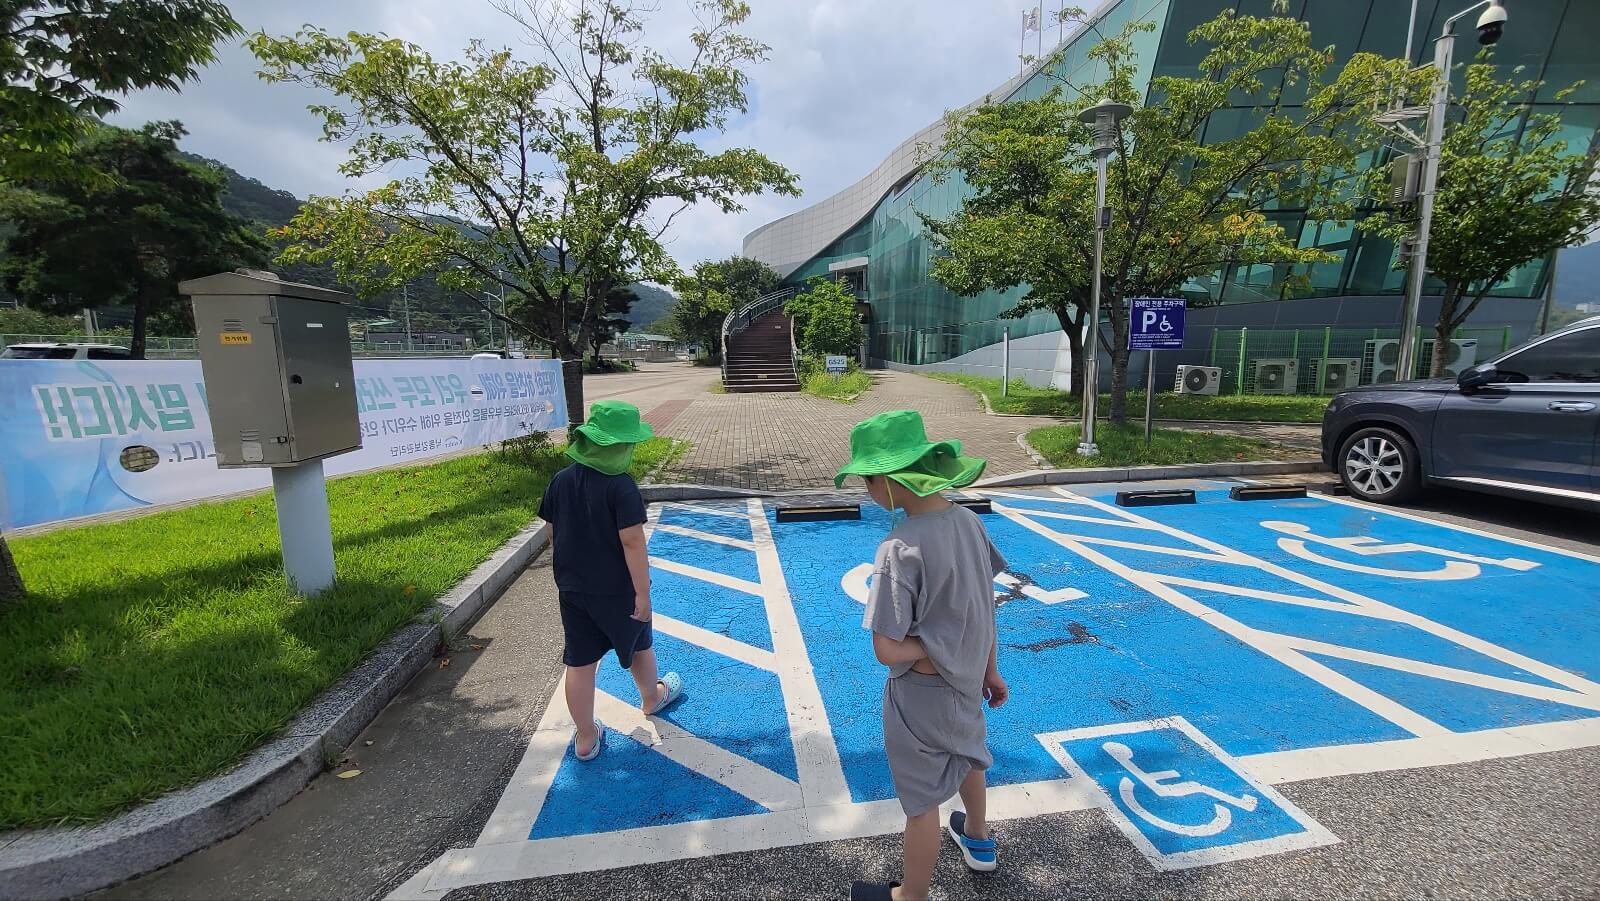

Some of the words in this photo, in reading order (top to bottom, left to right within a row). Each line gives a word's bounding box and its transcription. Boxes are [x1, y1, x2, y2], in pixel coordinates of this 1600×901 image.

[1134, 300, 1151, 308] 장애인
[1151, 300, 1162, 308] 전용
[1163, 300, 1185, 308] 주차구역
[1142, 310, 1157, 333] P
